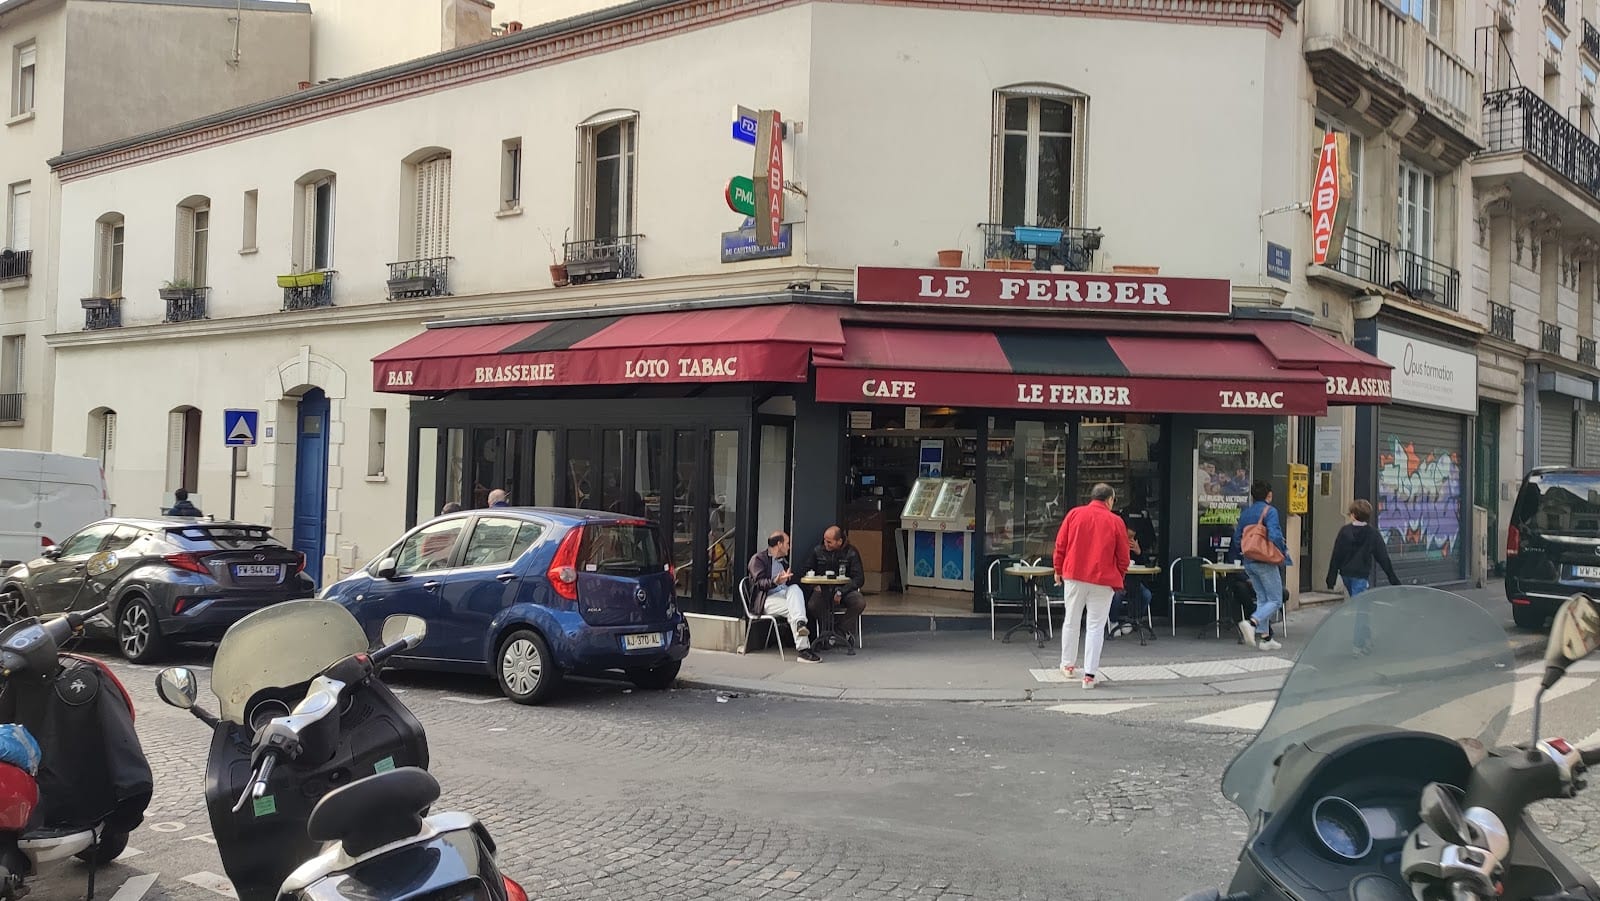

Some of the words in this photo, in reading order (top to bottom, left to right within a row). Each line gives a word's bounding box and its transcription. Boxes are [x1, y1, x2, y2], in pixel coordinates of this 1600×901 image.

[771, 121, 781, 236] TABAC
[735, 187, 754, 205] PMU
[1315, 143, 1336, 254] TABAC
[918, 275, 971, 298] LE
[999, 278, 1171, 306] FERBER
[474, 363, 555, 383] BRASSERIE
[625, 360, 669, 378] LOTO
[679, 356, 737, 377] TABAC
[1403, 342, 1423, 377] Opus
[1423, 360, 1454, 382] formation
[387, 371, 413, 386] BAR
[862, 379, 916, 399] CAFE
[1325, 376, 1392, 398] BRASSERIE
[1017, 384, 1046, 404] LE
[1049, 384, 1131, 406] FERBER
[1219, 390, 1284, 409] TABAC
[1212, 437, 1247, 446] PARIONS
